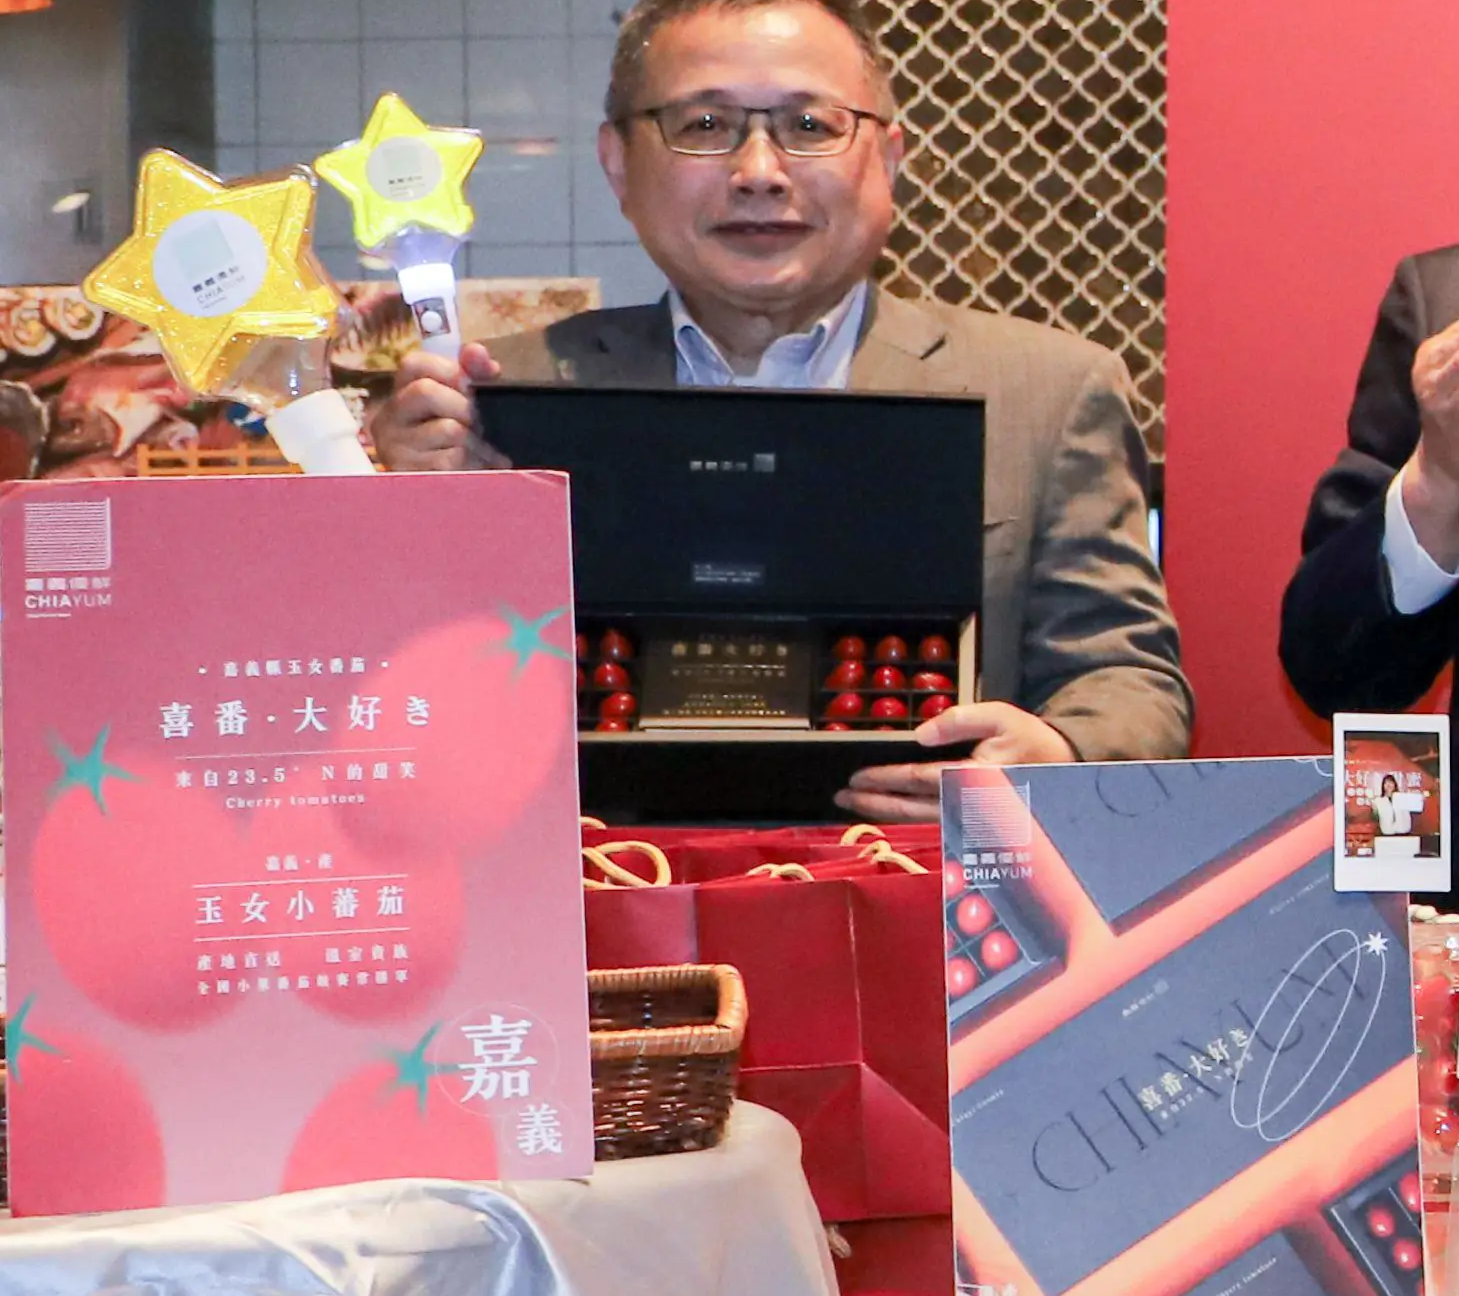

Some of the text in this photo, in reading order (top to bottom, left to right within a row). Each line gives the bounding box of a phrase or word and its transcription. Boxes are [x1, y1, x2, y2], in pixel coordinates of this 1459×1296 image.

[24, 593, 112, 609] CHIAYUM
[159, 694, 430, 739] 喜番·大好き
[226, 796, 281, 810] Cherry
[963, 865, 1033, 882] CHIAYUM
[195, 885, 406, 925] 玉女小蕃茄
[458, 1013, 563, 1157] 嘉義
